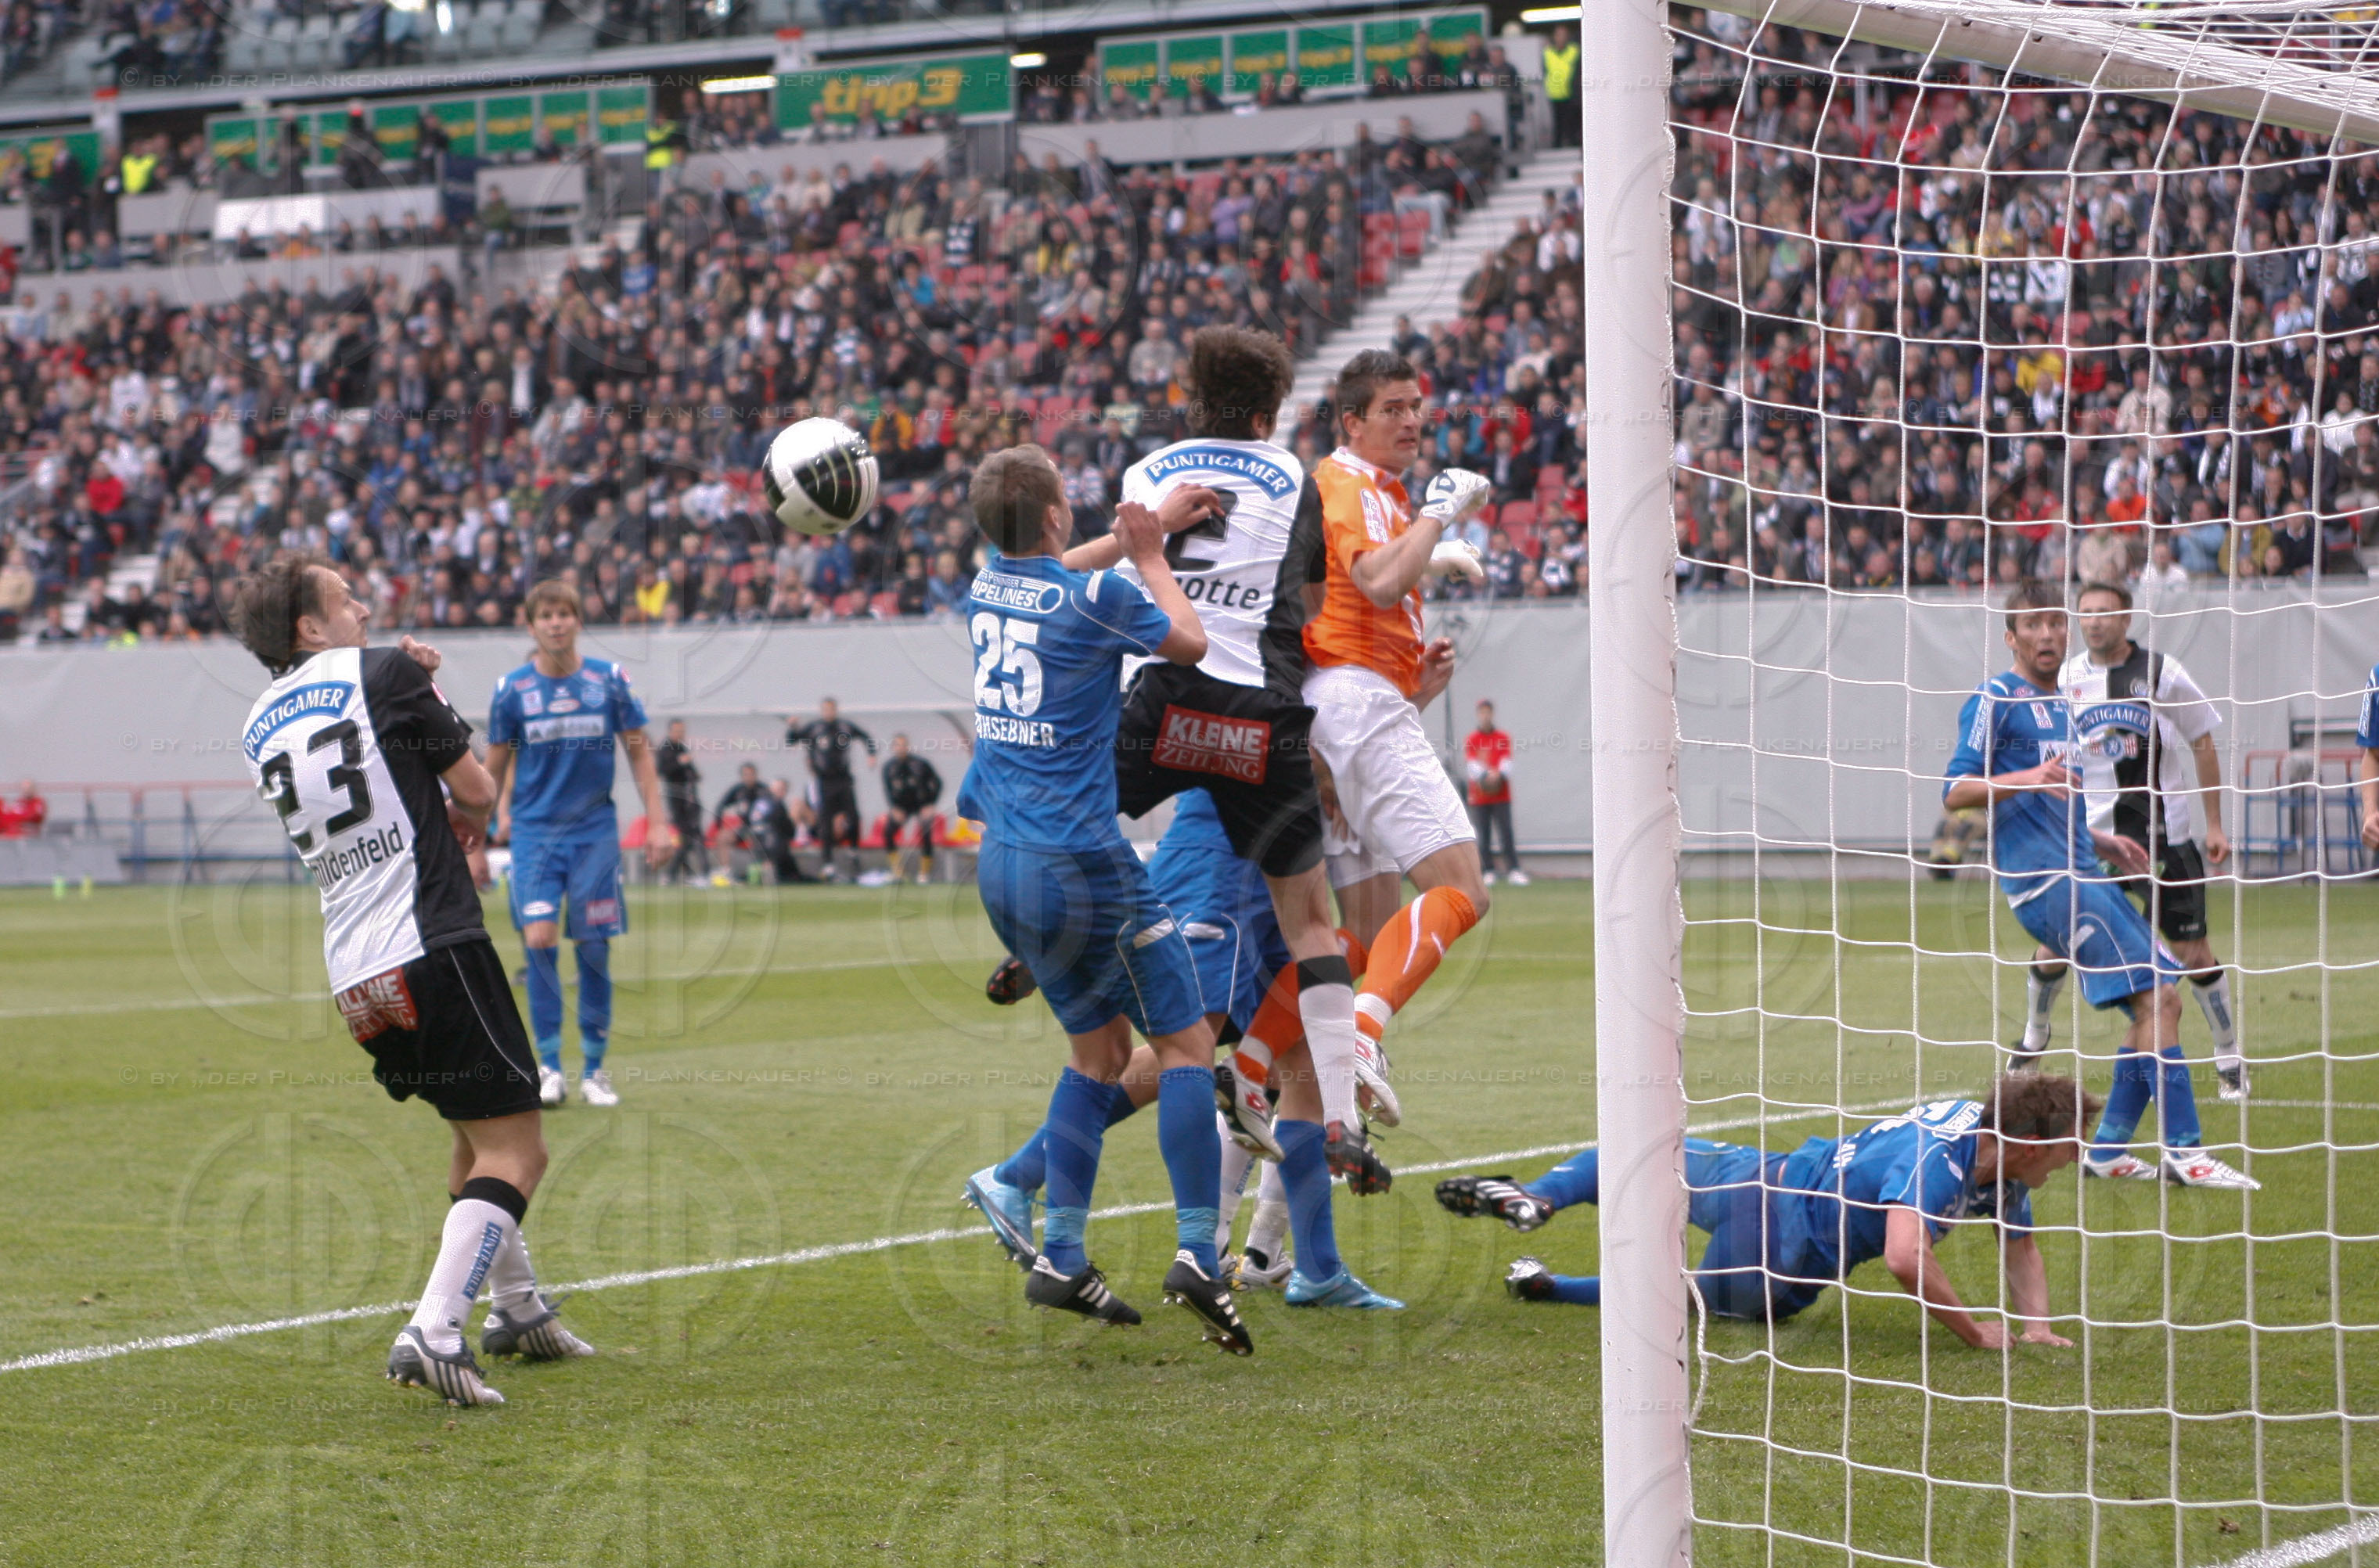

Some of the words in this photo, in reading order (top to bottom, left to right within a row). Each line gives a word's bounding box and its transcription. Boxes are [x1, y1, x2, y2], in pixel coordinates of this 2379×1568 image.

[1148, 453, 1288, 493] PUNTIGAMER
[971, 611, 1042, 717] 25
[244, 688, 344, 755] PUNTIGAMER
[260, 718, 374, 856] 23
